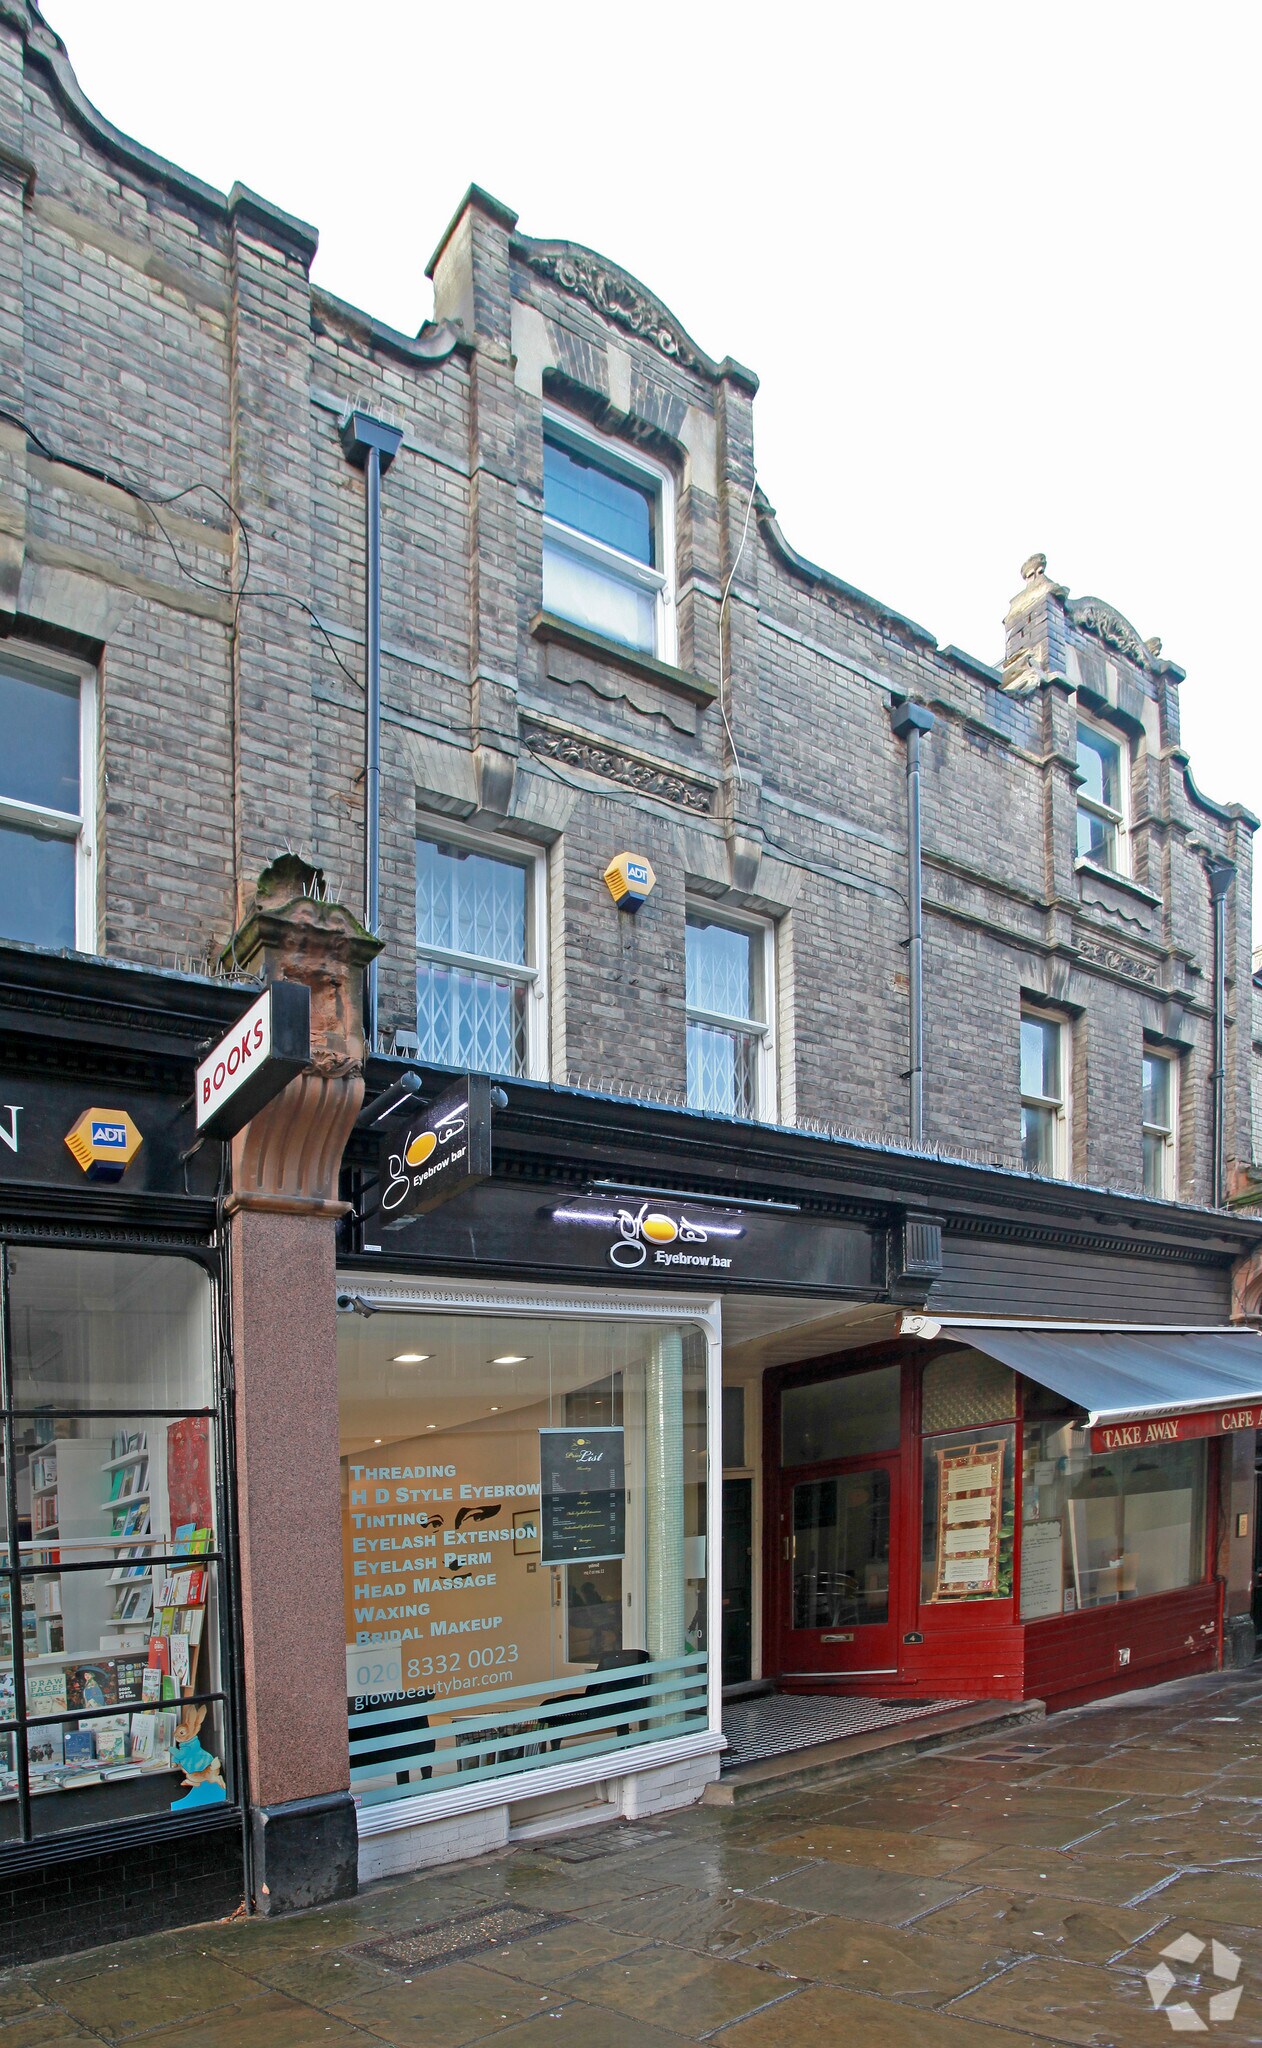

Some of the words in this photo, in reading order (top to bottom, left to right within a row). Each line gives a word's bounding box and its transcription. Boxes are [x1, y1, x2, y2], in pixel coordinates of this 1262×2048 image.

[627, 867, 648, 881] ADT
[203, 1018, 263, 1105] BOOKS
[92, 1127, 126, 1143] ADT
[413, 1155, 450, 1187] Eyebrow
[451, 1146, 468, 1163] bar
[655, 1250, 710, 1266] Eyebrow
[711, 1254, 733, 1268] bar
[1221, 1410, 1254, 1430] CAFE
[1102, 1426, 1142, 1448] TAKE
[1144, 1420, 1179, 1442] AWAY
[575, 1449, 604, 1463] List
[350, 1464, 457, 1481] THREADING
[351, 1489, 367, 1505] H
[375, 1488, 390, 1504] D
[395, 1487, 453, 1503] STYLE
[459, 1483, 541, 1499] EYEBROW
[351, 1512, 428, 1529] TINTING
[352, 1535, 436, 1553] EYELASH
[443, 1526, 537, 1546] EXTENSION
[353, 1556, 437, 1576] EYELASH
[444, 1551, 492, 1568] PERM
[354, 1583, 406, 1600] HEAD
[413, 1573, 497, 1594] MASSAGE
[354, 1603, 430, 1624] WAXING
[355, 1627, 424, 1646] BRIDAL
[430, 1616, 503, 1637] MAKEUP
[356, 1662, 401, 1686] 020
[407, 1652, 461, 1678] 8332
[468, 1644, 519, 1669] 0023
[30, 1678, 63, 1687] DRAW
[30, 1684, 63, 1693] FACES
[354, 1669, 513, 1711] glowbeautybar.com
